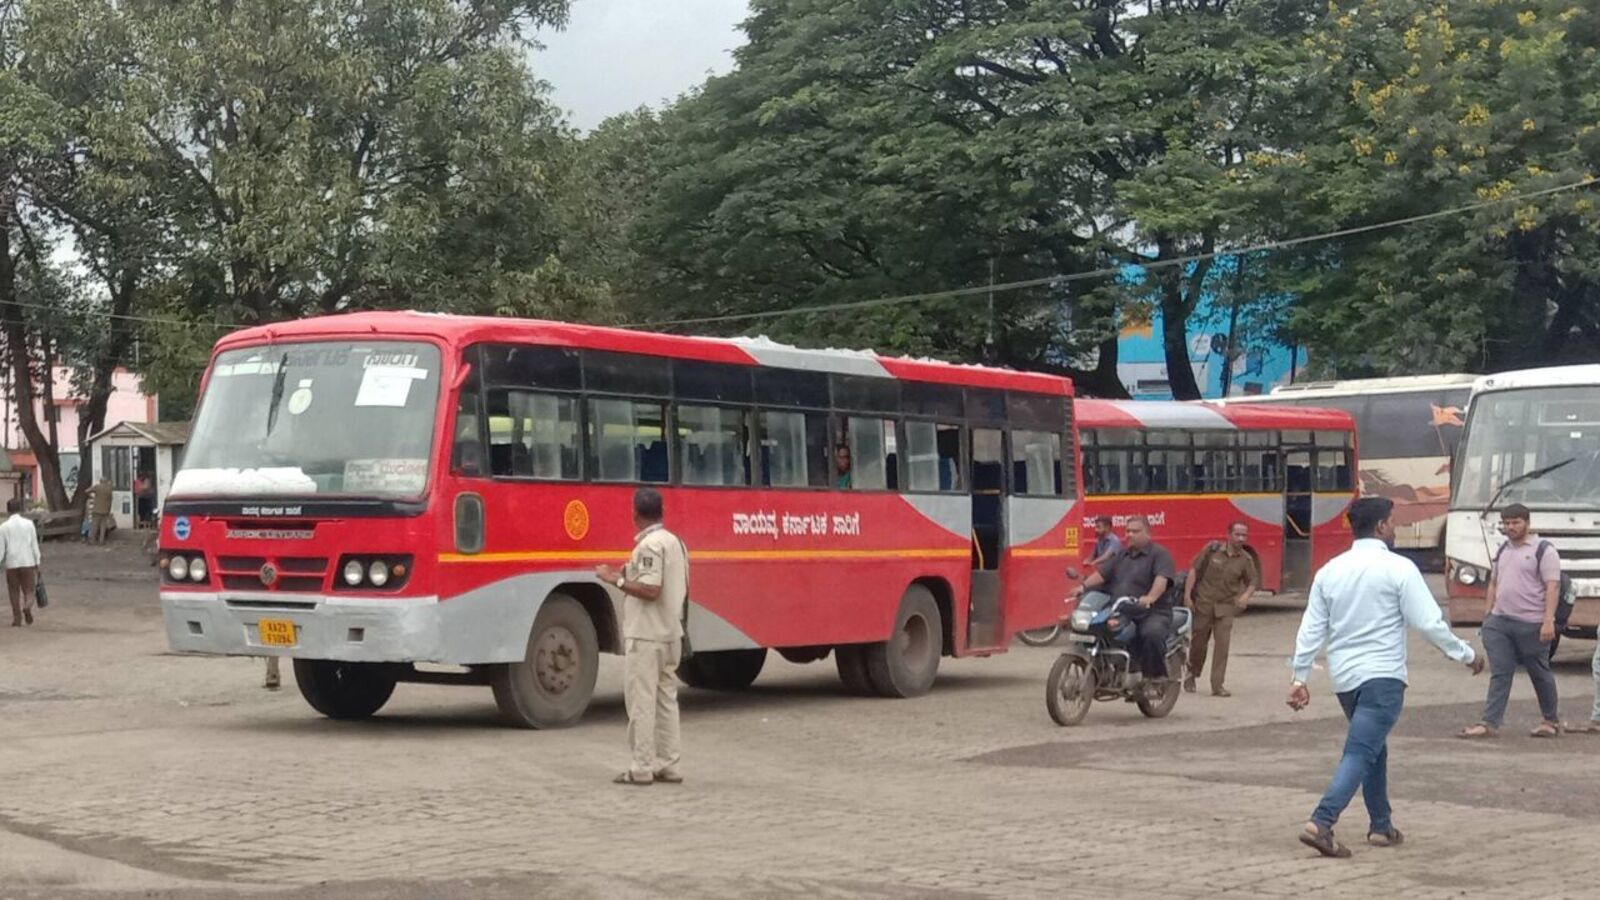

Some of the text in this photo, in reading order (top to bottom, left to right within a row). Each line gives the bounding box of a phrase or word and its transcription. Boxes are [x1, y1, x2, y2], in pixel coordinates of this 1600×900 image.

[733, 510, 860, 540] ವಾಯವ್ಯ ಕರ್ನಾಟಕ ಸಾರಿಗೆ
